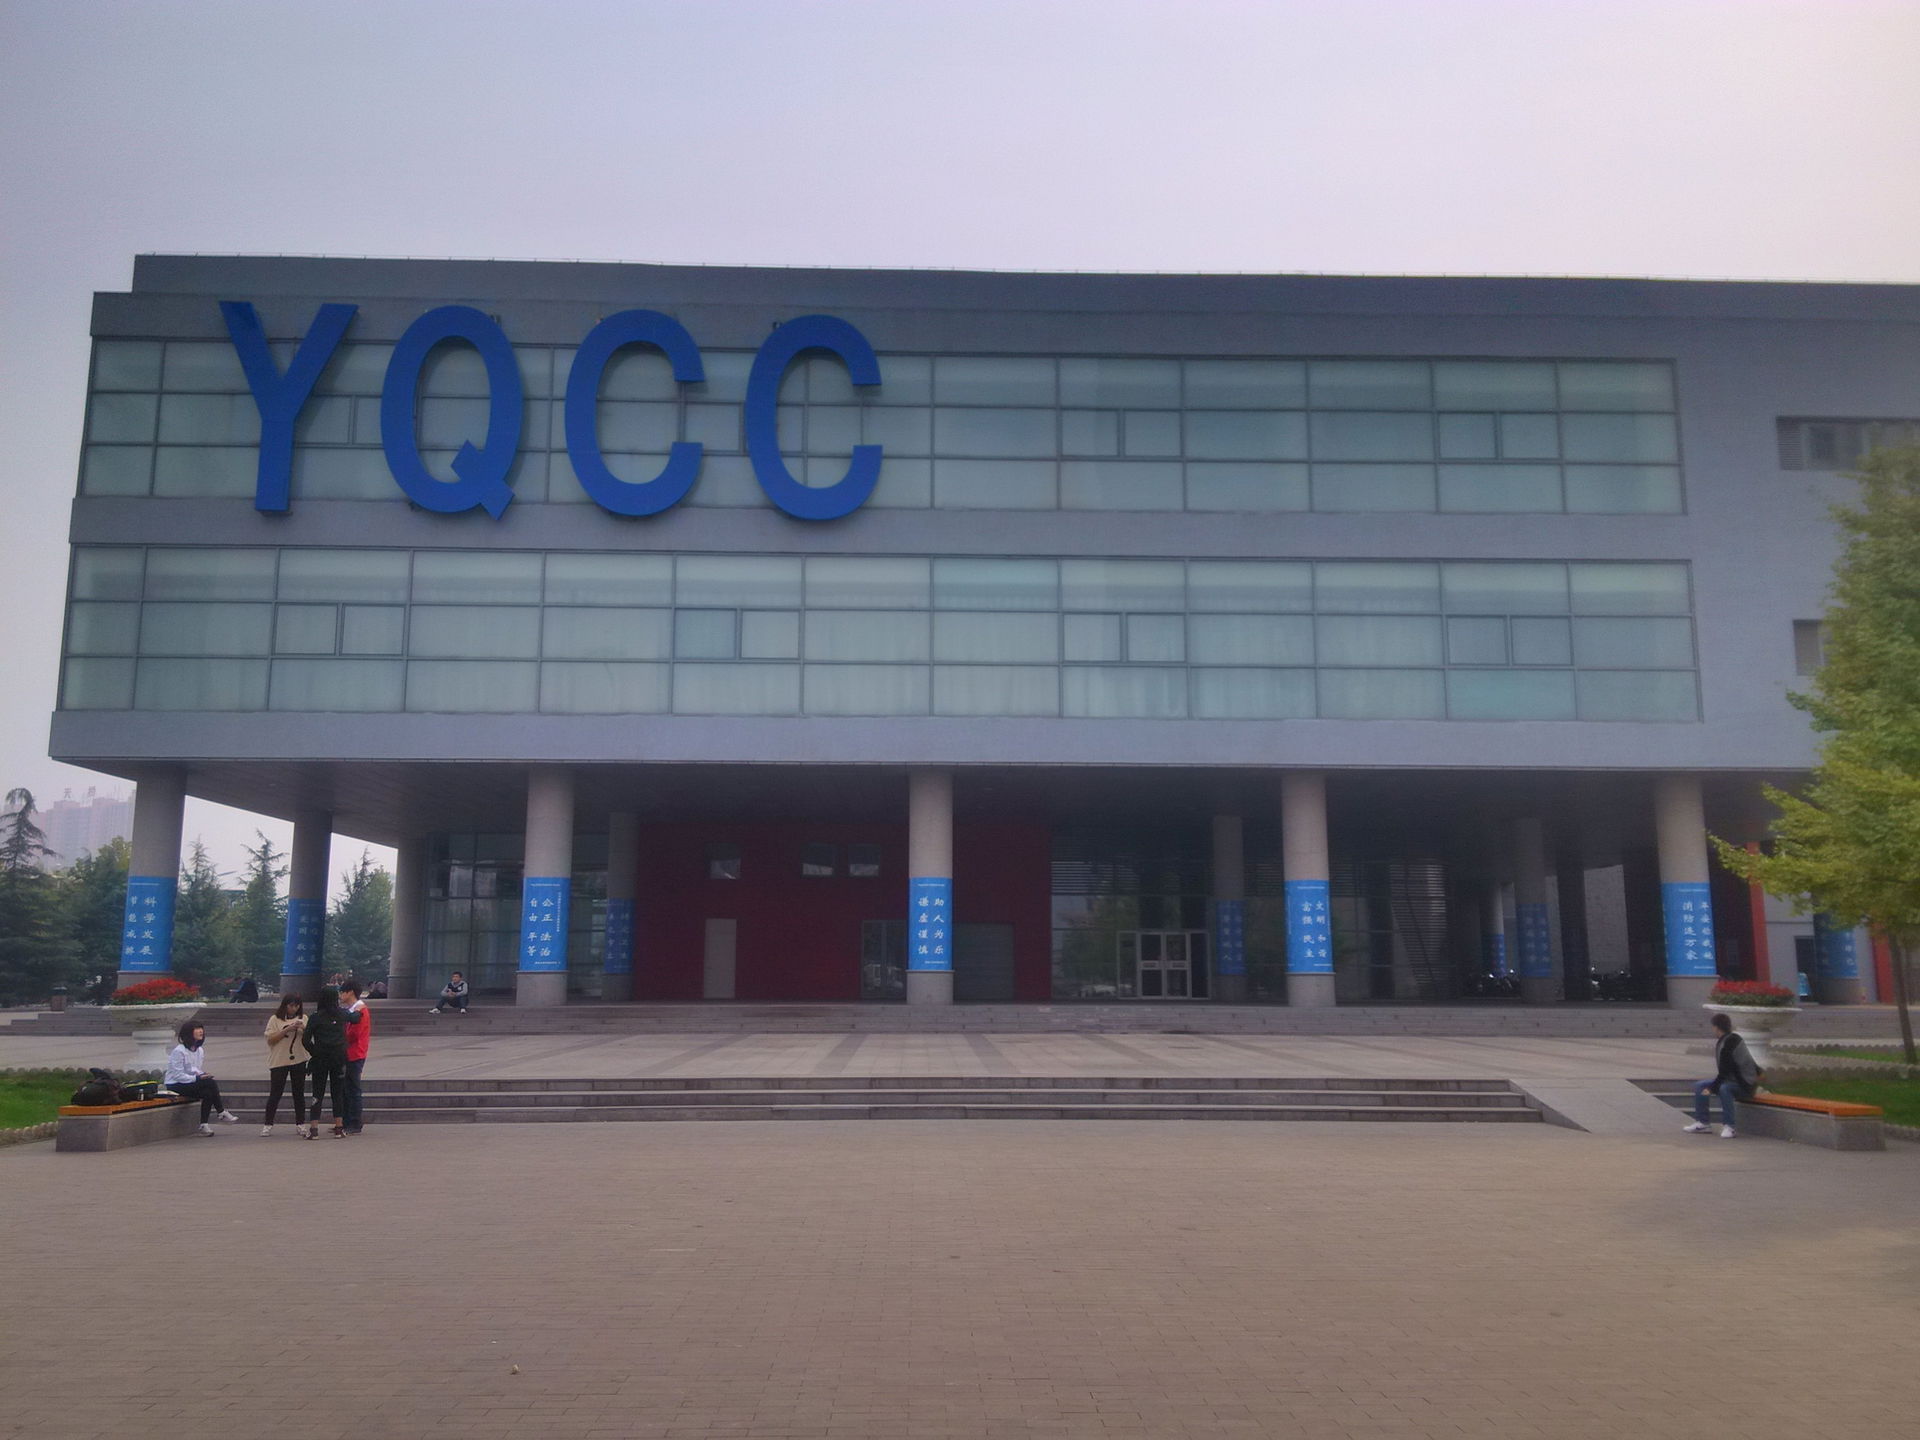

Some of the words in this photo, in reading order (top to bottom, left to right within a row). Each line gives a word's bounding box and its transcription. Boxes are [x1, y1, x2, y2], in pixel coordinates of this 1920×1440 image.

[219, 300, 884, 519] YQCC
[140, 895, 158, 956] 科学发展
[526, 897, 538, 957] 自由平等
[539, 897, 554, 957] 公正法治
[917, 895, 930, 955] 谦虚谨慎
[933, 897, 945, 955] 助人为乐
[1302, 900, 1315, 958] 富强民主
[1315, 900, 1327, 958] 文明和谐
